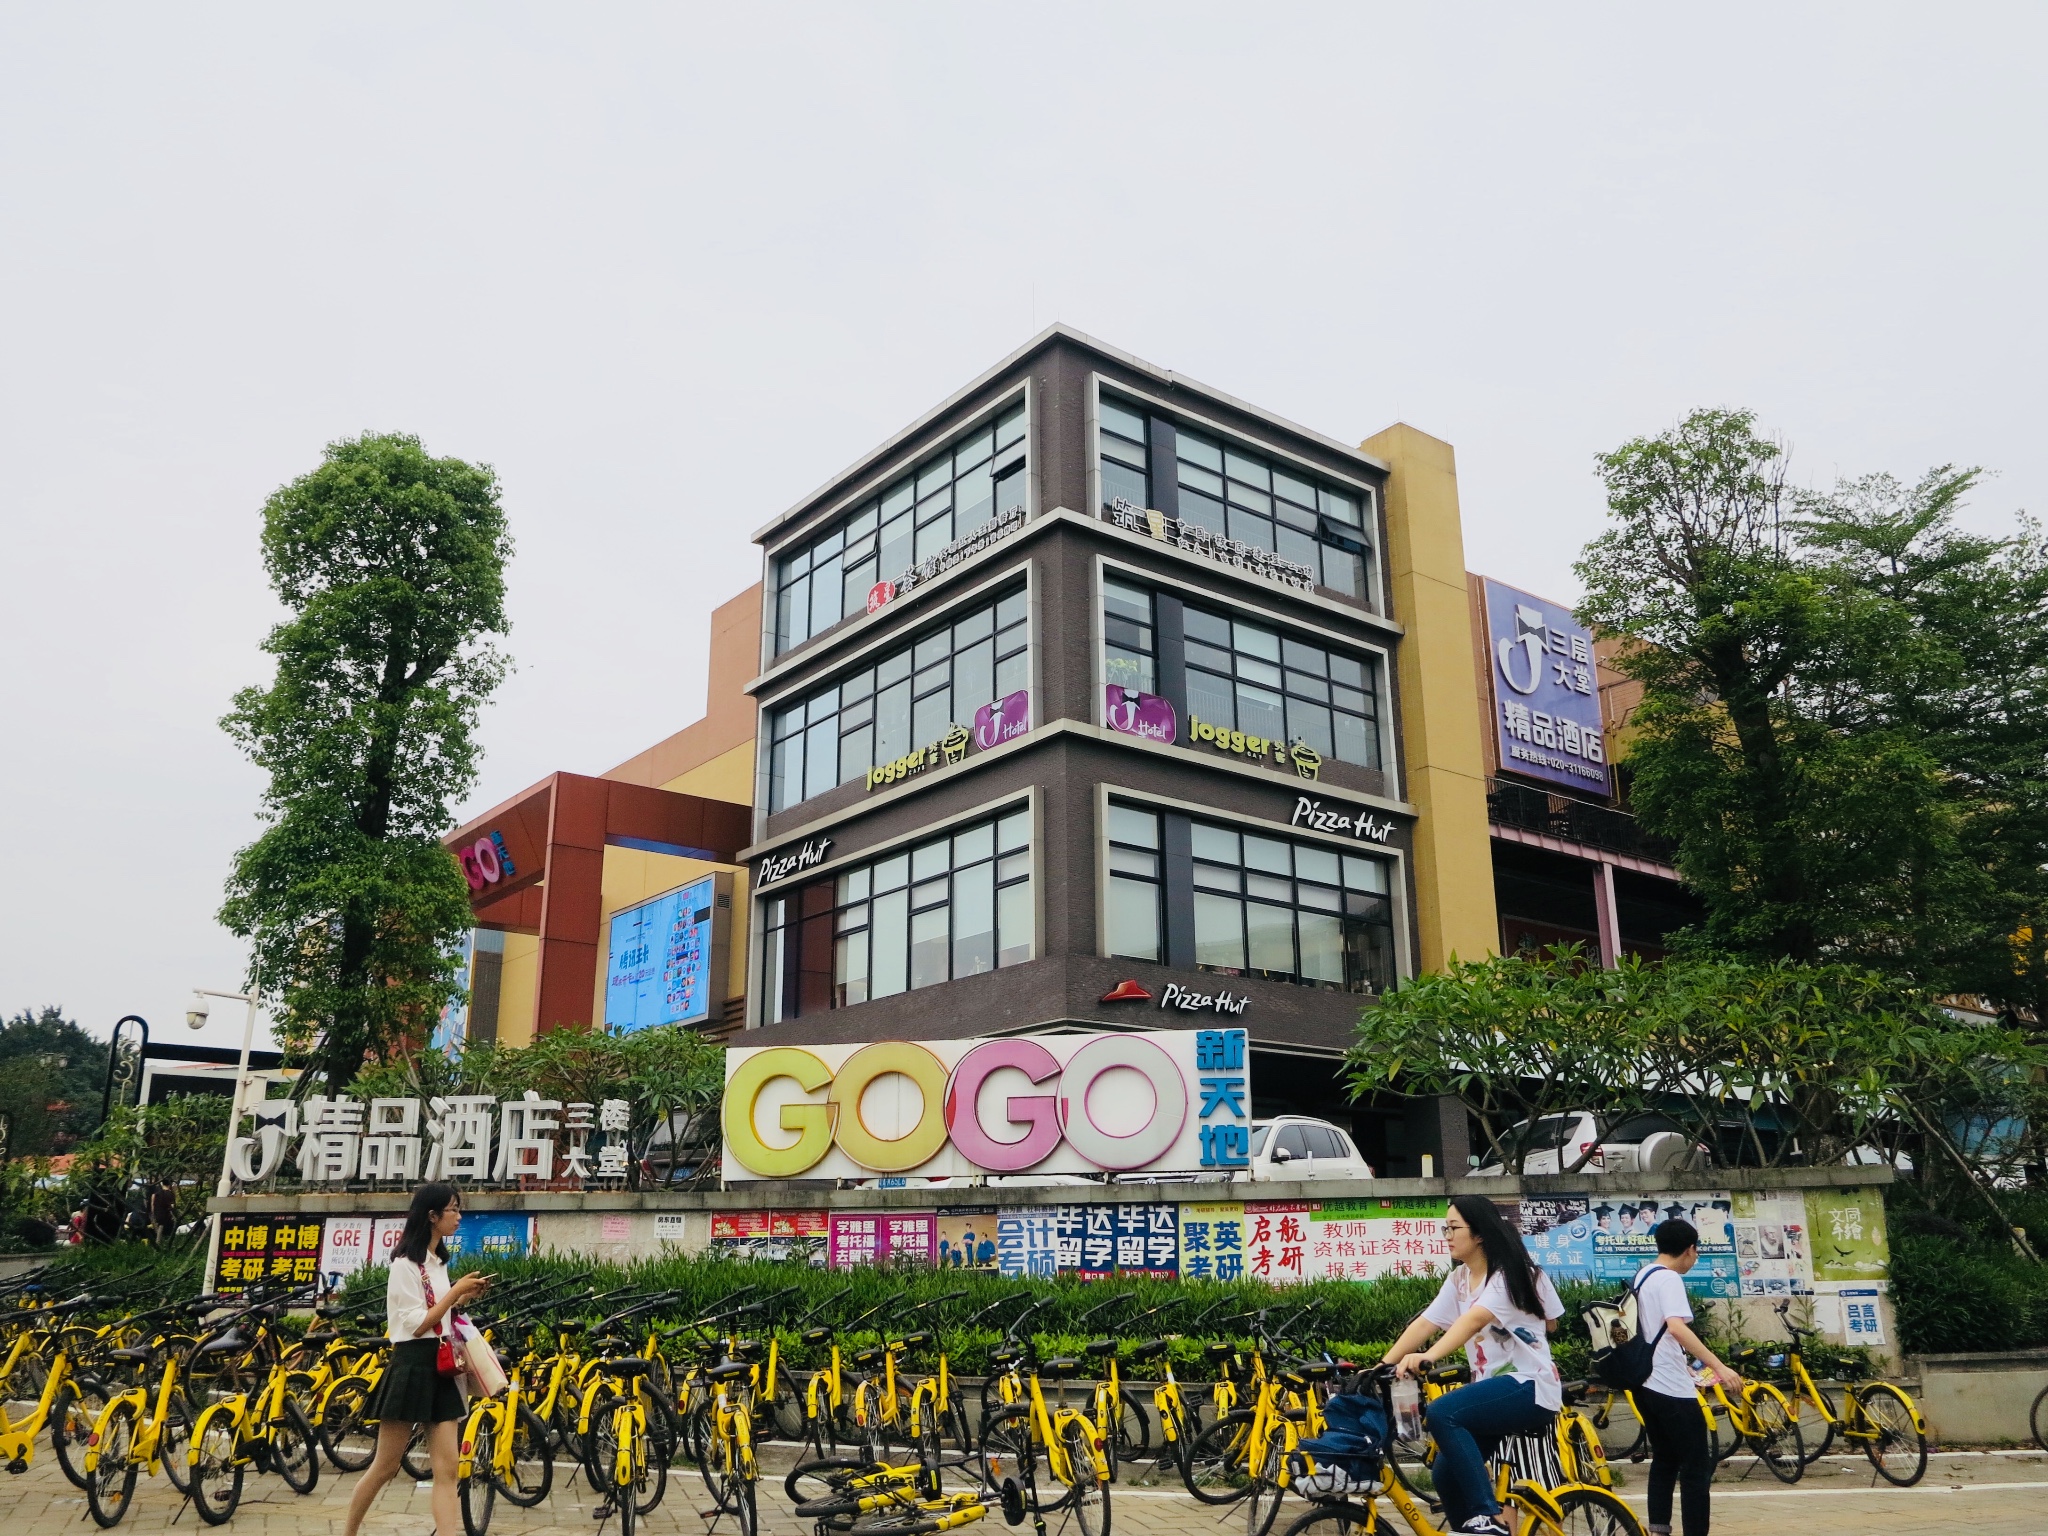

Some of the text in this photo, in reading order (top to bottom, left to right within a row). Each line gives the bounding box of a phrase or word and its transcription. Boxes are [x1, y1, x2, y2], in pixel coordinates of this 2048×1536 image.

[1550, 628, 1590, 665] 三层
[1553, 660, 1593, 696] 大堂
[1003, 716, 1027, 740] Hotel
[1138, 719, 1167, 740] Hotel
[1503, 699, 1604, 764] 精品酒店
[1291, 797, 1397, 842] Pizza Hut
[757, 837, 833, 889] Pizza Hut
[1161, 983, 1252, 1014] Pizza Hut
[721, 1034, 1188, 1177] GOGO
[1196, 1029, 1249, 1166] 新天地
[565, 1099, 630, 1131] 三楼
[296, 1089, 562, 1182] 精品酒店
[561, 1145, 630, 1179] 大堂
[1323, 1201, 1368, 1212] 优越教育
[1391, 1199, 1438, 1210] 优越教育
[1828, 1207, 1861, 1223] 文同
[836, 1220, 875, 1234] 学雅思
[889, 1220, 928, 1233] 学雅思
[1057, 1205, 1113, 1236] 毕达
[1118, 1205, 1175, 1234] 毕达
[1247, 1215, 1307, 1247] 启航
[1323, 1222, 1366, 1238] 教师
[1392, 1220, 1436, 1236] 教师
[224, 1225, 268, 1250] 中博
[275, 1225, 320, 1250] 中博
[332, 1229, 361, 1246] GRE
[382, 1230, 404, 1248] GR
[836, 1234, 875, 1248] 考托福
[889, 1234, 928, 1248] 考托福
[997, 1219, 1055, 1249] 会计
[1183, 1221, 1242, 1253] 聚英
[1381, 1238, 1449, 1255] 资格证
[1534, 1234, 1570, 1249] 健身
[836, 1249, 875, 1263] 去留学
[1057, 1237, 1113, 1267] 留学
[1117, 1236, 1175, 1266] 留学
[1252, 1245, 1305, 1276] 考研
[1313, 1240, 1380, 1258] 资格证
[1529, 1250, 1584, 1265] 教练证
[220, 1258, 265, 1282] 考研
[270, 1257, 316, 1282] 考研
[998, 1249, 1056, 1281] 专硕
[1186, 1254, 1244, 1282] 考研
[1325, 1261, 1368, 1278] 报考
[1393, 1259, 1437, 1277] 报考
[1848, 1318, 1878, 1333] 考研
[1404, 1502, 1420, 1522] ofo
